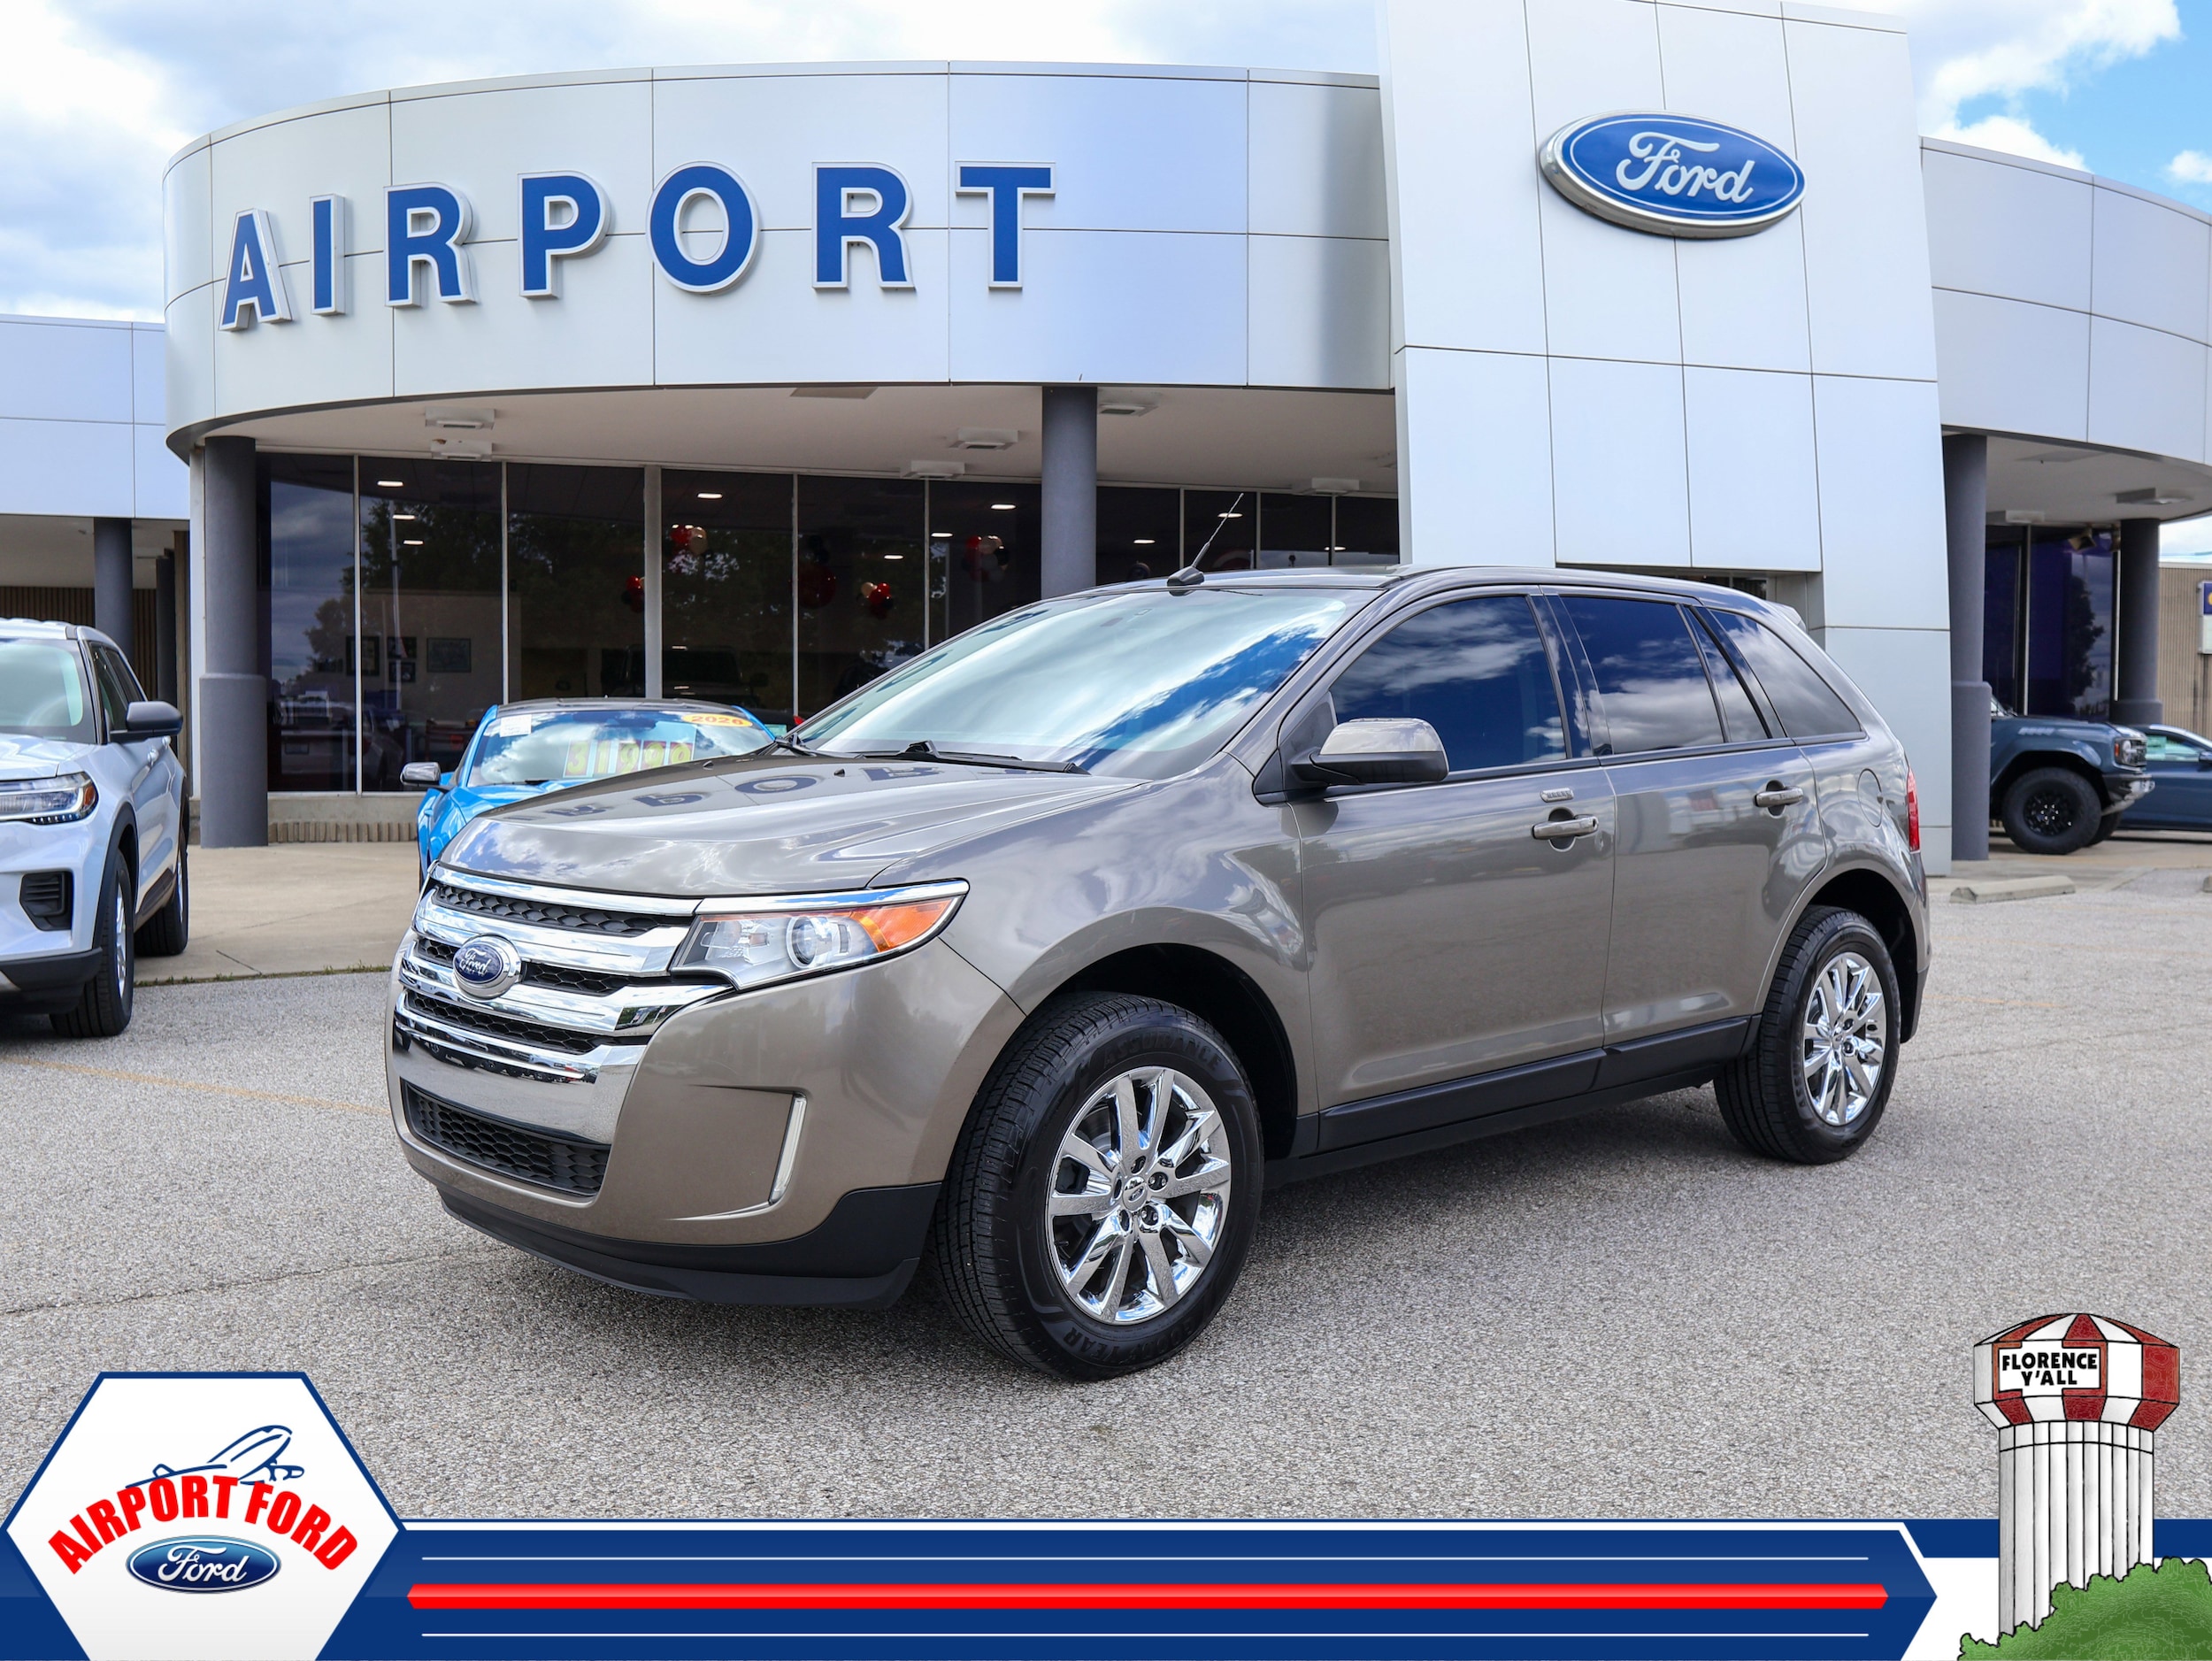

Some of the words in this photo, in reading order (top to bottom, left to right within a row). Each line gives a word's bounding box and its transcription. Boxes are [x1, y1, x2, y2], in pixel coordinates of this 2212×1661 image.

[1616, 131, 1755, 204] Ford
[219, 160, 1056, 331] AIRPORT
[459, 947, 492, 976] Ford
